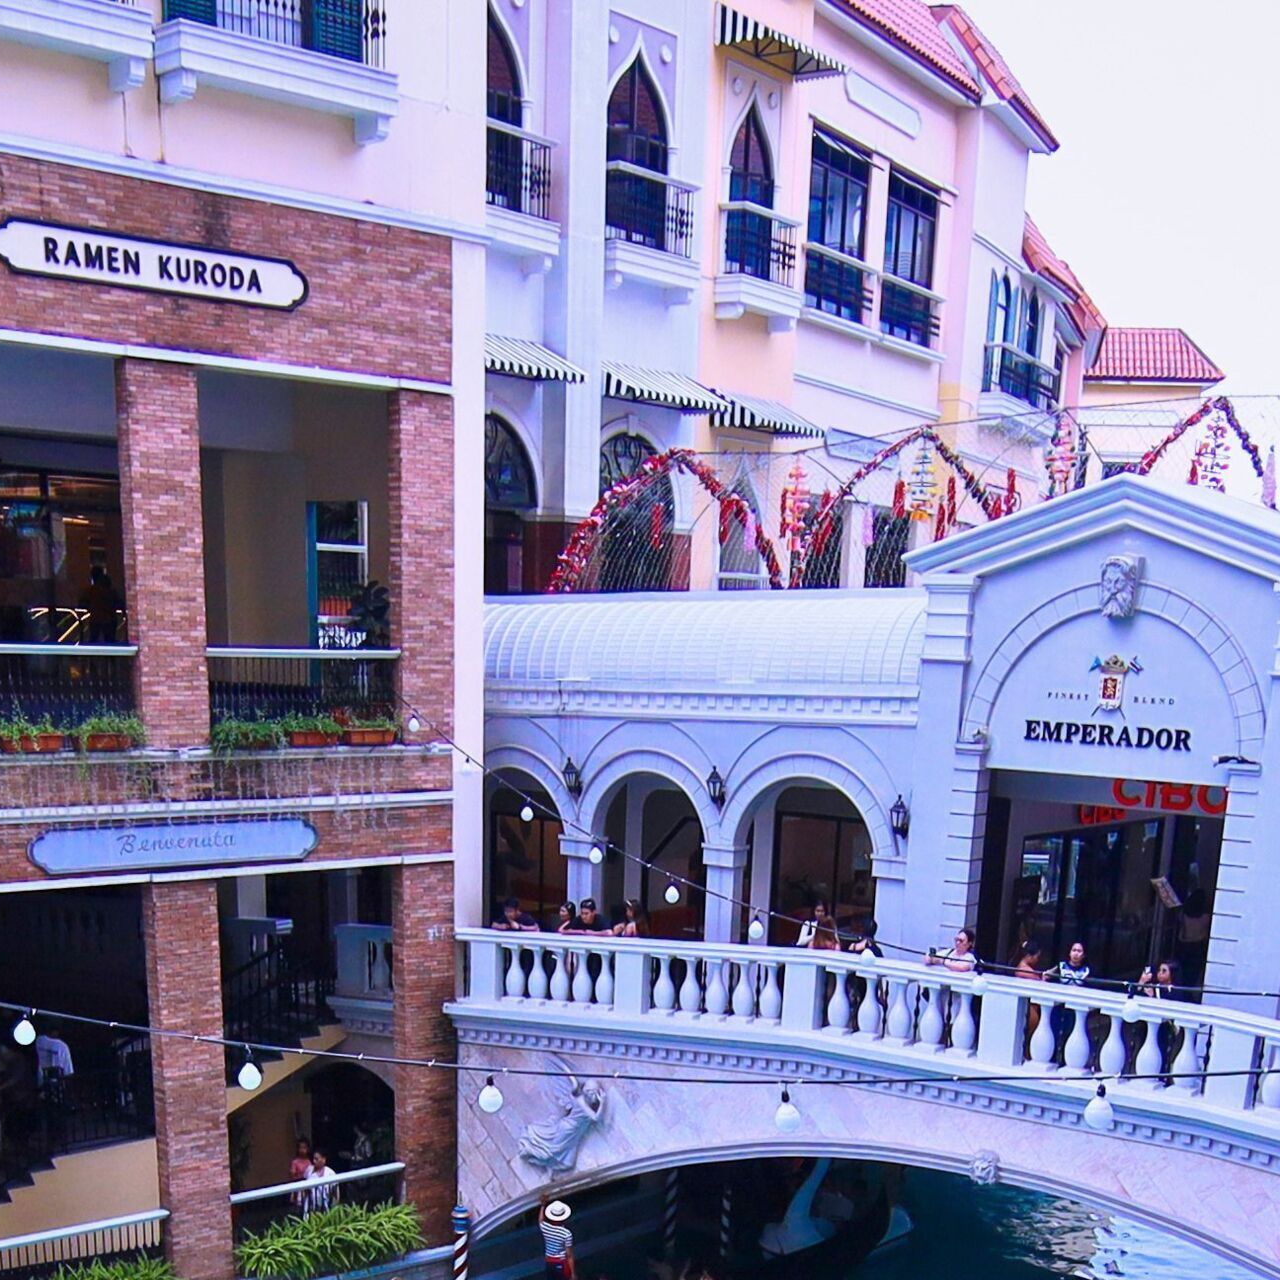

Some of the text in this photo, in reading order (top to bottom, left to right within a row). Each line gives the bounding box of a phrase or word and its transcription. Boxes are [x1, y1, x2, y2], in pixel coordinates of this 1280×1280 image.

[43, 236, 263, 294] RAMEN KURODA
[1047, 691, 1175, 706] FINEST BLEND
[1023, 719, 1192, 752] EMPERADOR
[1111, 777, 1229, 815] CIBO
